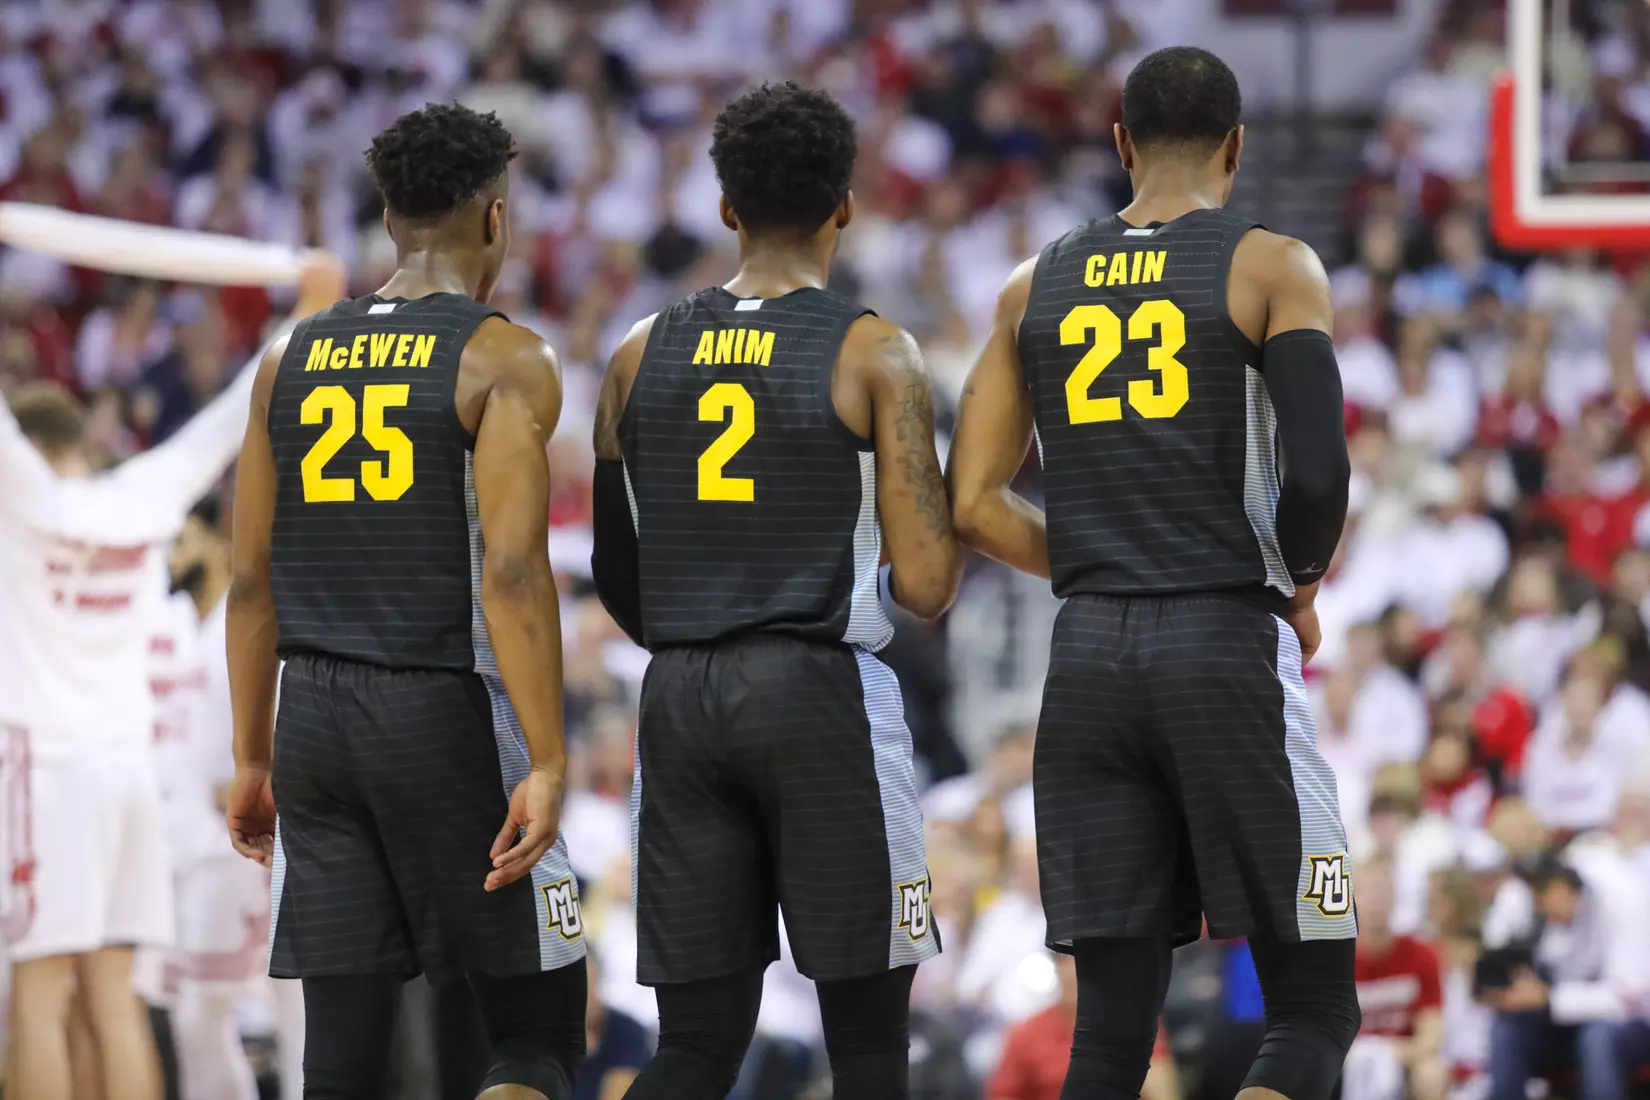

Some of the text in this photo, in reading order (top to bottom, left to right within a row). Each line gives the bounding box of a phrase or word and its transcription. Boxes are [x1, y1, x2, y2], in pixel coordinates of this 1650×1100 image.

[1084, 250, 1168, 287] CAIN
[304, 333, 437, 371] McEWEN
[692, 329, 776, 367] ANIM
[1059, 299, 1190, 425] 23
[300, 384, 414, 503] 25
[697, 382, 755, 502] 2
[541, 878, 583, 941] MU
[898, 878, 930, 941] MU
[1302, 854, 1351, 917] MU
